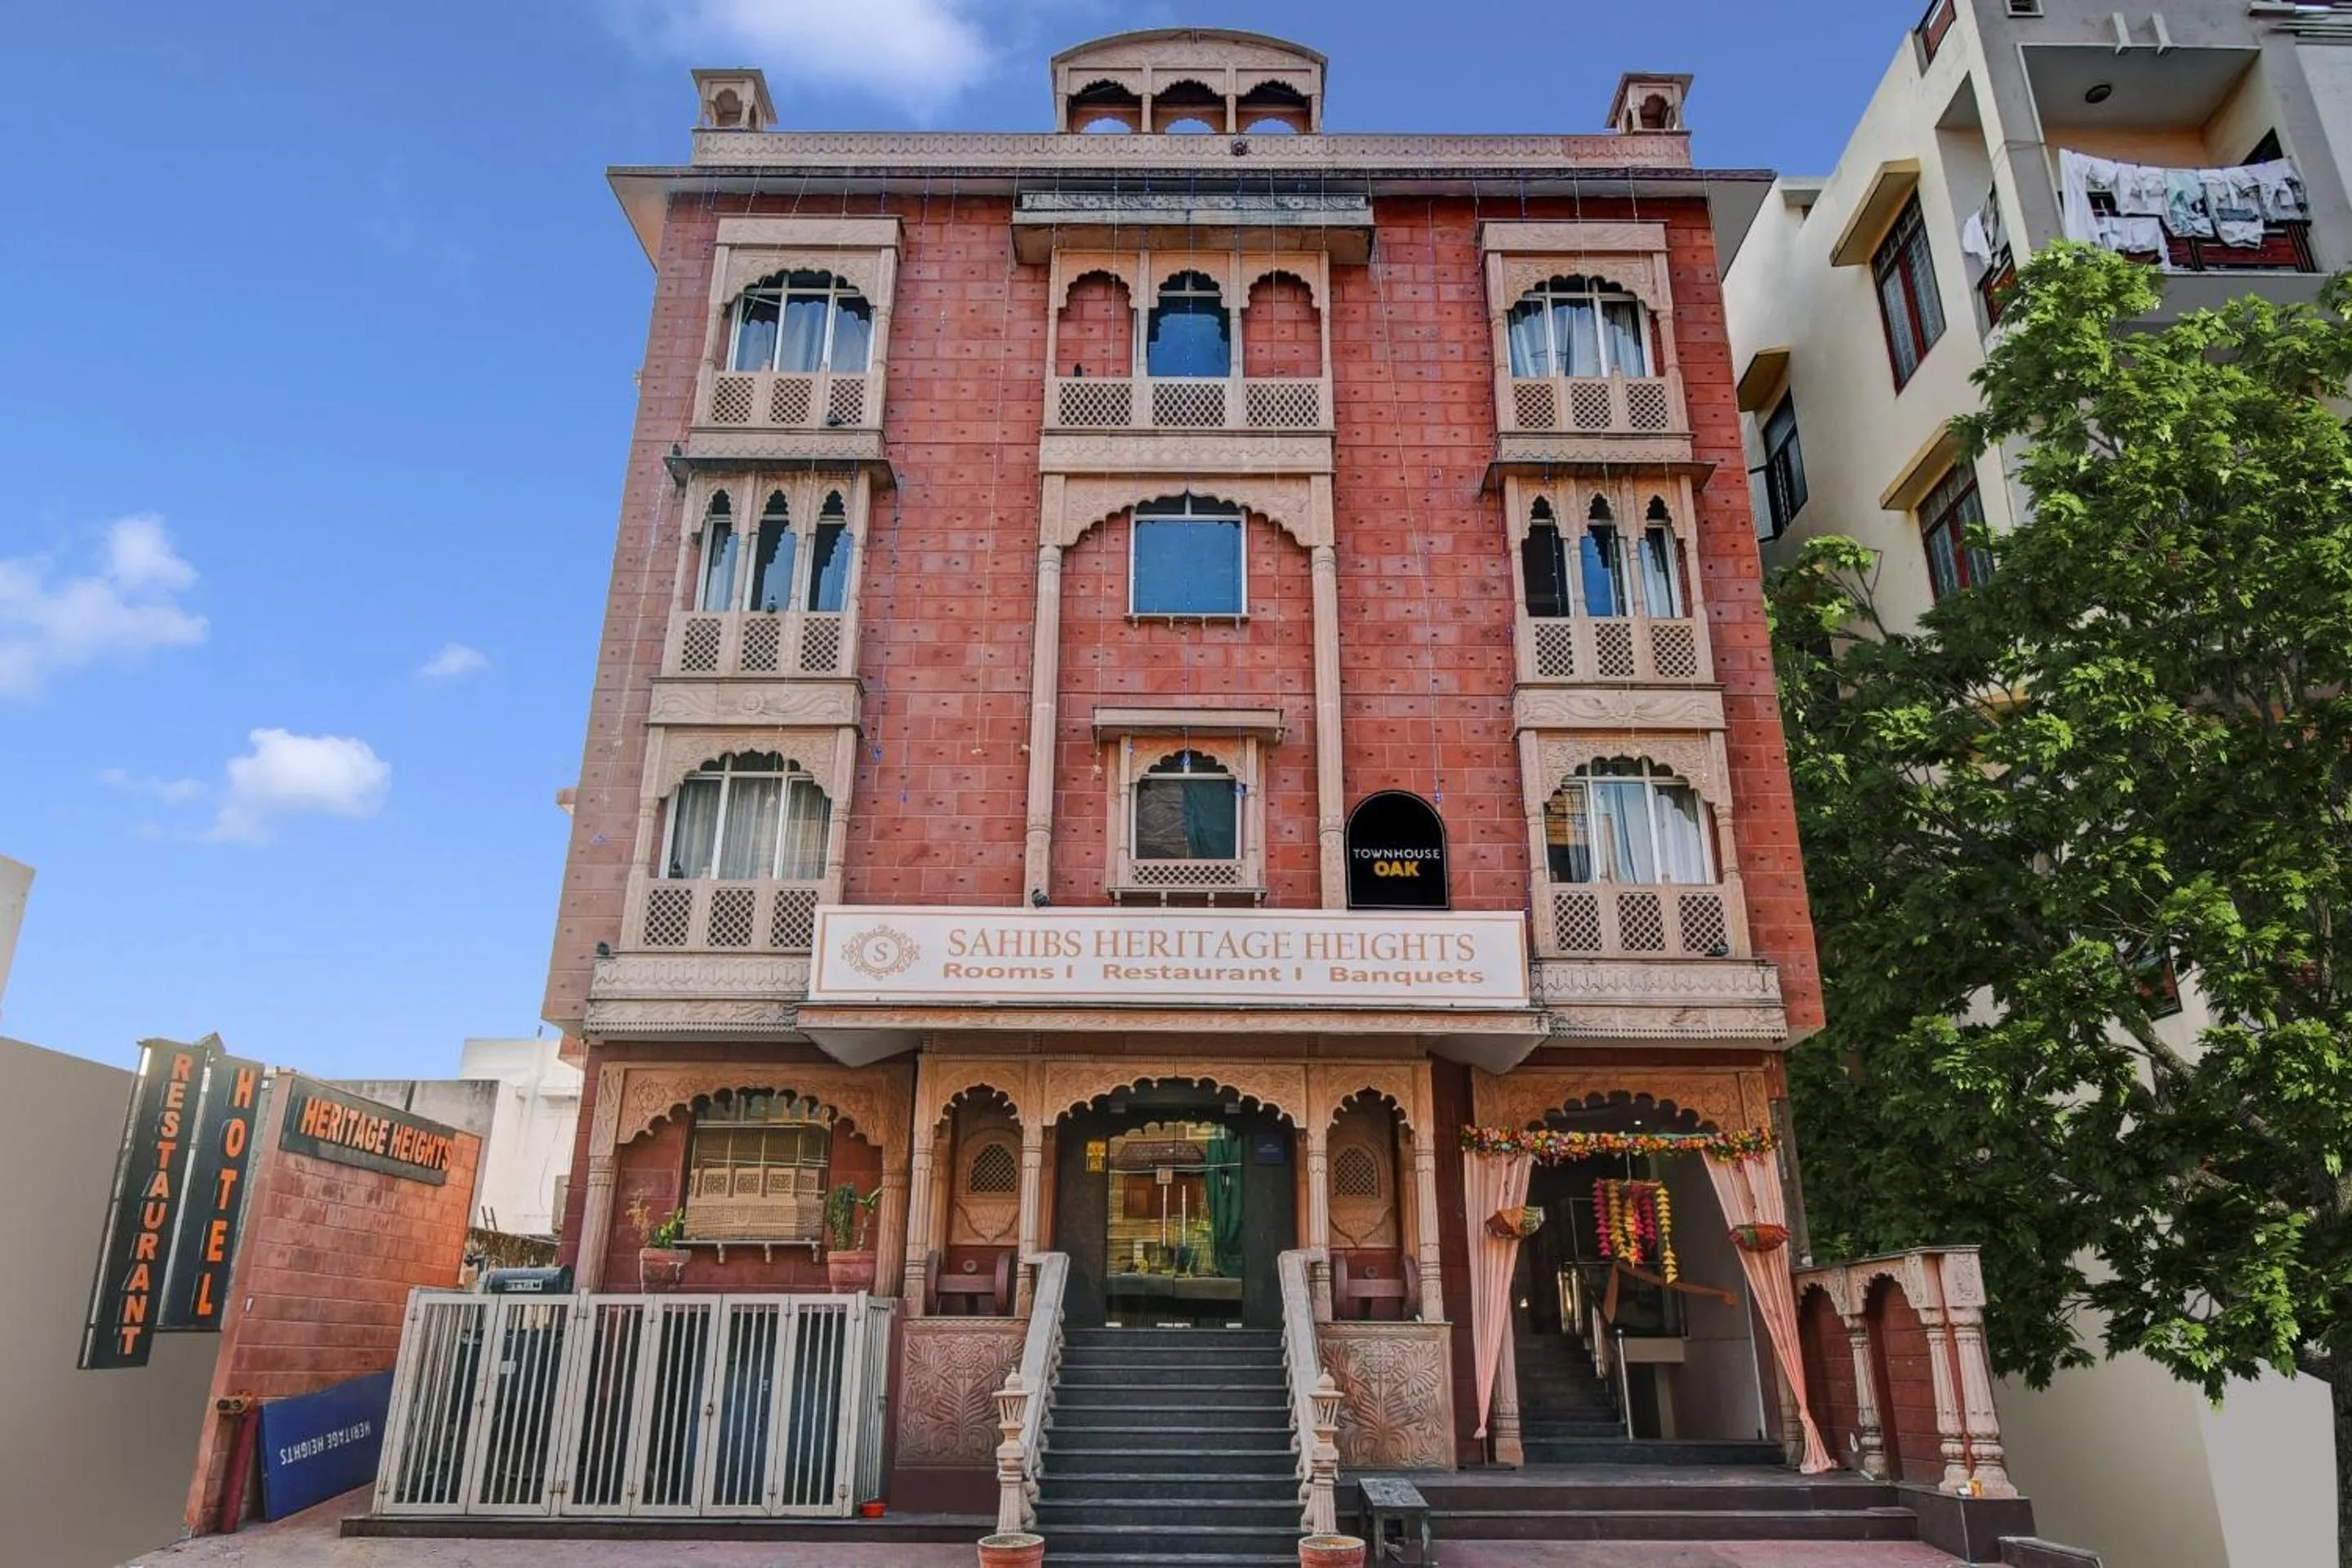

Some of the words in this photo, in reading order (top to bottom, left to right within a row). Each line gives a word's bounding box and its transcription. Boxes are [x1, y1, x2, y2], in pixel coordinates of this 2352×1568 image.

[1353, 849, 1441, 859] TOWNHOUSE
[1374, 860, 1420, 877] OAK
[947, 929, 1081, 957] SAHIBS
[1093, 929, 1293, 959] HERITAGE
[1303, 932, 1475, 961] HEIGHTS
[943, 964, 1054, 979] Rooms
[1102, 964, 1281, 981] Restaurant
[1329, 966, 1485, 987] Banquets
[300, 1097, 390, 1155] HERITAGE
[389, 1123, 453, 1169] HEIGHTS
[121, 1053, 193, 1355] RESTAURANT
[197, 1067, 256, 1316] HOTEL
[327, 1421, 371, 1449] HERITAGE
[280, 1437, 324, 1465] HEIGHTS
